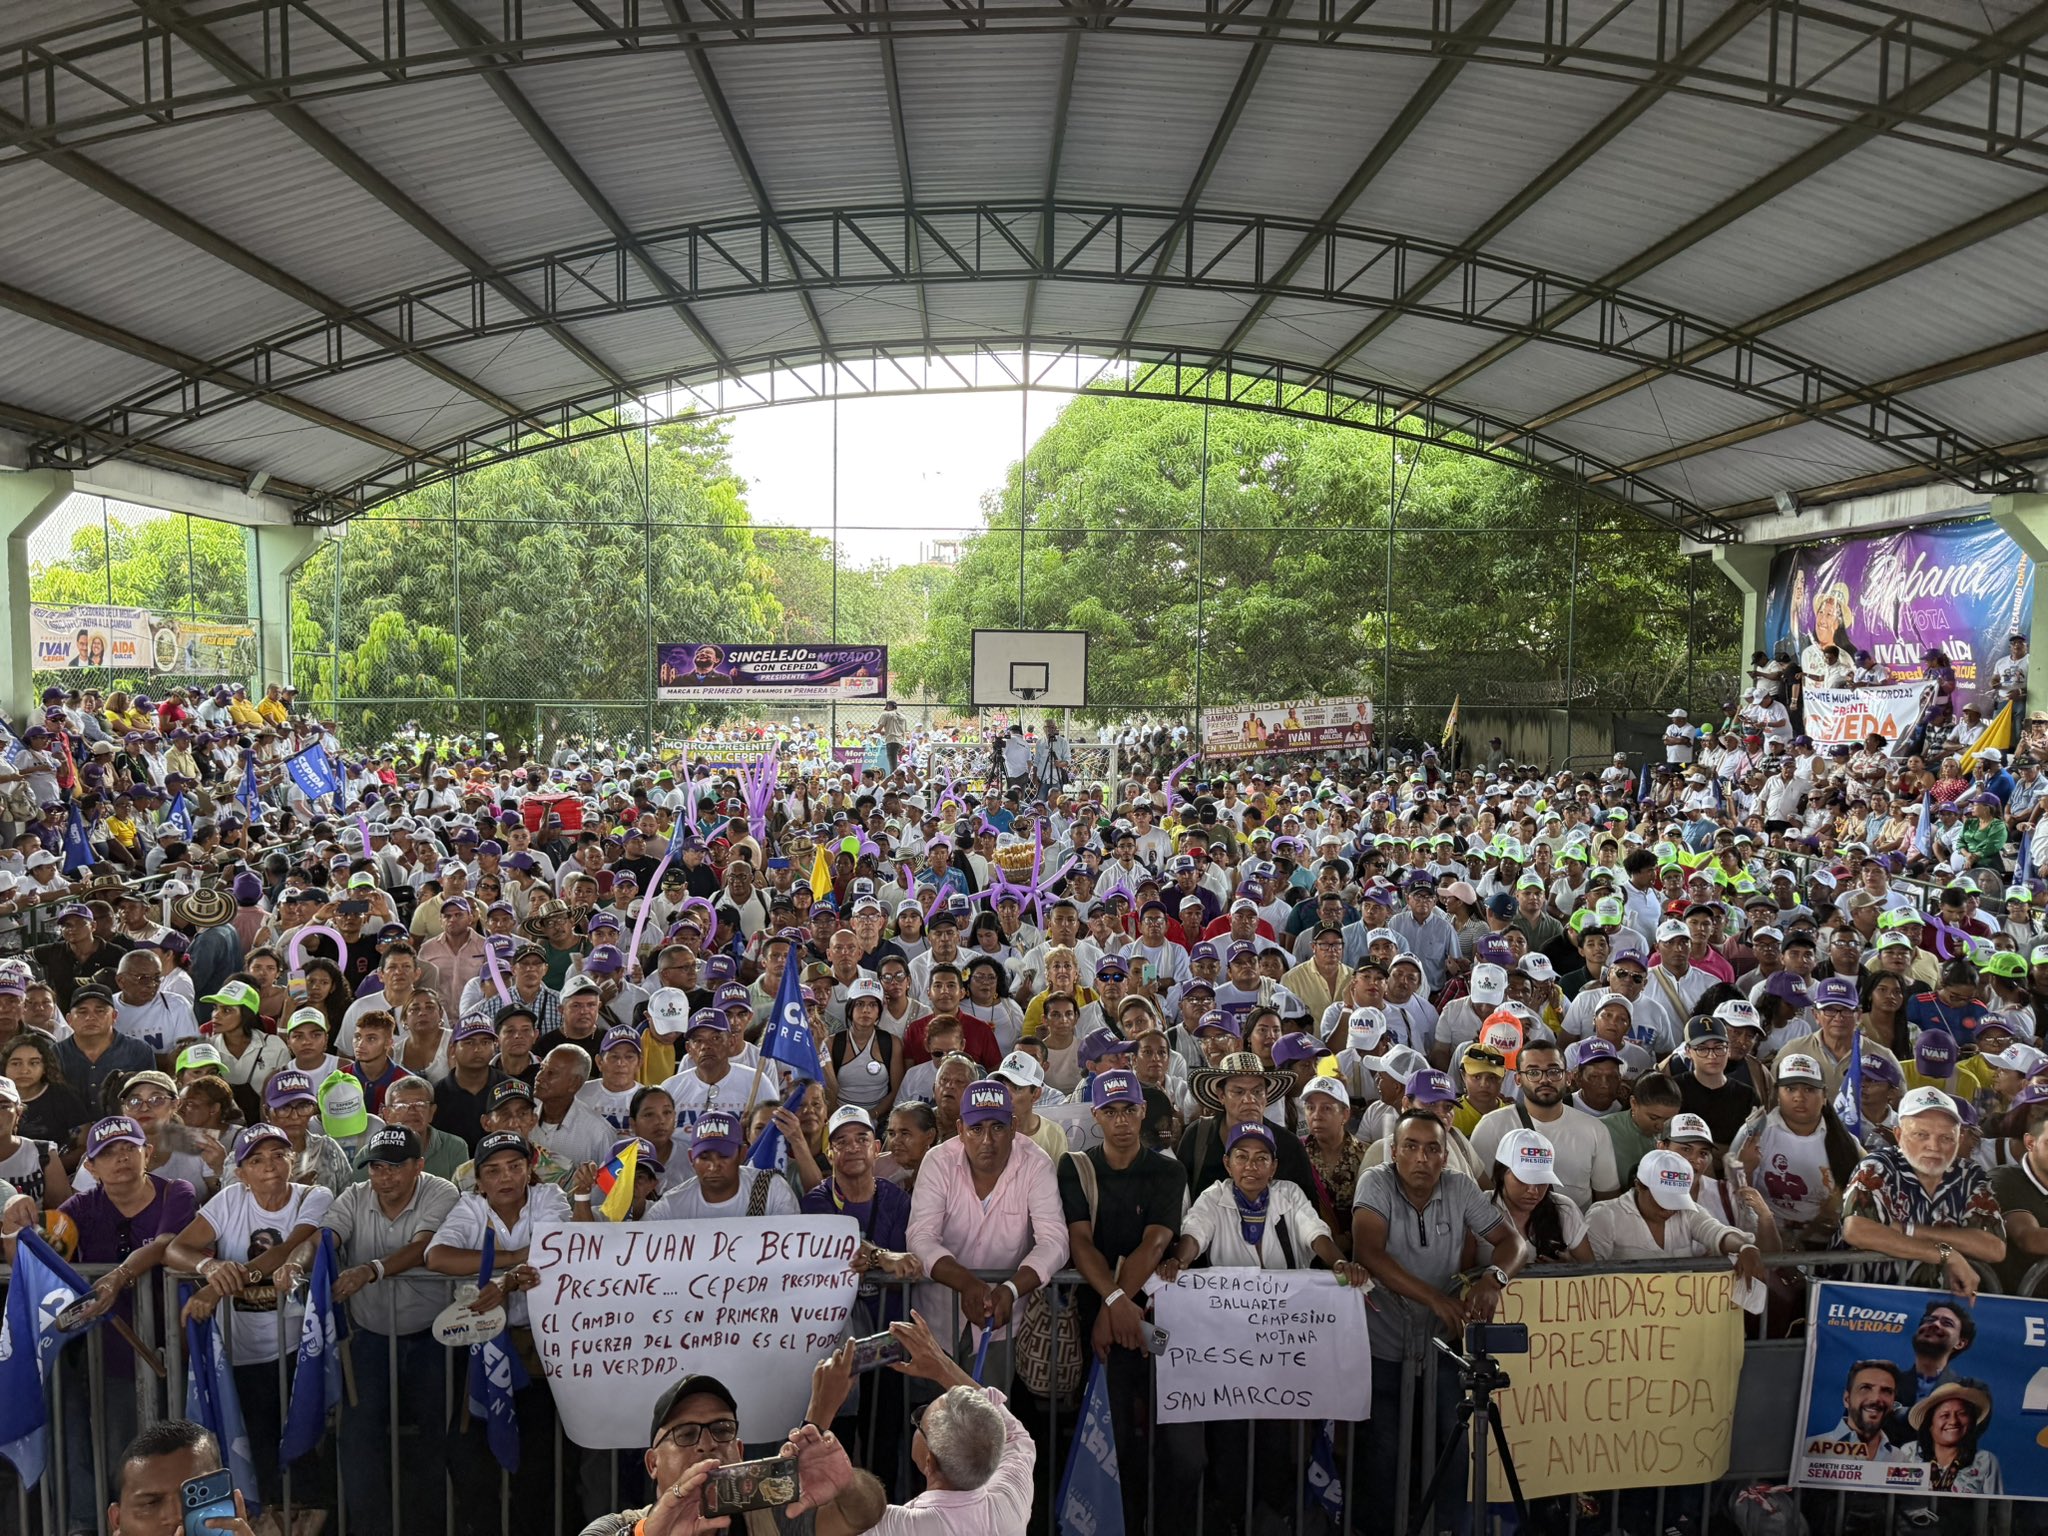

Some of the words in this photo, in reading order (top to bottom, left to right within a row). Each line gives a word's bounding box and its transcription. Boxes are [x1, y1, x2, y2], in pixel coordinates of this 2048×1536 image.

[728, 649, 806, 663] SINCELEJO
[817, 650, 874, 663] MORADO
[753, 664, 775, 672] CON
[780, 662, 818, 671] CEPEDA
[702, 687, 743, 695] PRIMERO
[1203, 702, 1280, 715] BIENVENIDO
[1318, 695, 1370, 706] CEPEDA
[719, 741, 773, 751] PRESENTE
[1227, 742, 1258, 750] VUELVA
[1521, 1147, 1553, 1158] CEPEDA
[1660, 1169, 1692, 1181] CEPEDA
[539, 1231, 604, 1270] SAN
[616, 1231, 696, 1267] JUAN
[709, 1231, 743, 1263] DE
[756, 1230, 856, 1265] BETULIA
[689, 1273, 768, 1304] CEPEDA
[782, 1269, 855, 1292] PRESIDENTE
[1163, 1274, 1289, 1295] EDERACIÓN
[1209, 1296, 1287, 1310] BALUARTE
[541, 1312, 560, 1334] EL
[571, 1311, 635, 1332] CAMBIO
[653, 1308, 673, 1324] ES
[684, 1308, 704, 1324] EN
[716, 1306, 779, 1327] PRIMERA
[791, 1305, 848, 1324] VUELTA
[1248, 1309, 1336, 1326] CAMPESINO
[1828, 1304, 1845, 1318] EL
[1848, 1306, 1908, 1325] PODER
[1827, 1318, 1840, 1327] de
[1840, 1318, 1849, 1327] la
[1848, 1320, 1904, 1334] VERDAD
[543, 1340, 561, 1358] LA
[571, 1335, 632, 1360] FUERZA
[644, 1333, 673, 1350] DEL
[680, 1330, 740, 1350] CAMBIO
[752, 1331, 770, 1348] ES
[780, 1332, 796, 1350] EL
[1256, 1329, 1318, 1345] MOJANA
[1168, 1347, 1307, 1368] PRESENTE
[1528, 1324, 1681, 1374] PRESENTE
[545, 1360, 563, 1379] DE
[573, 1362, 593, 1378] LA
[603, 1356, 684, 1376] VERDAD.
[1163, 1391, 1206, 1411] SAN
[1213, 1384, 1313, 1408] MARCOS
[1584, 1376, 1714, 1422] CEPEDA
[1547, 1425, 1683, 1477] AMAMOS
[1808, 1440, 1868, 1457] APOYA
[1807, 1468, 1862, 1480] SENADOR
[1808, 1462, 1838, 1470] AGMETH
[1840, 1463, 1864, 1471] ESCAF
